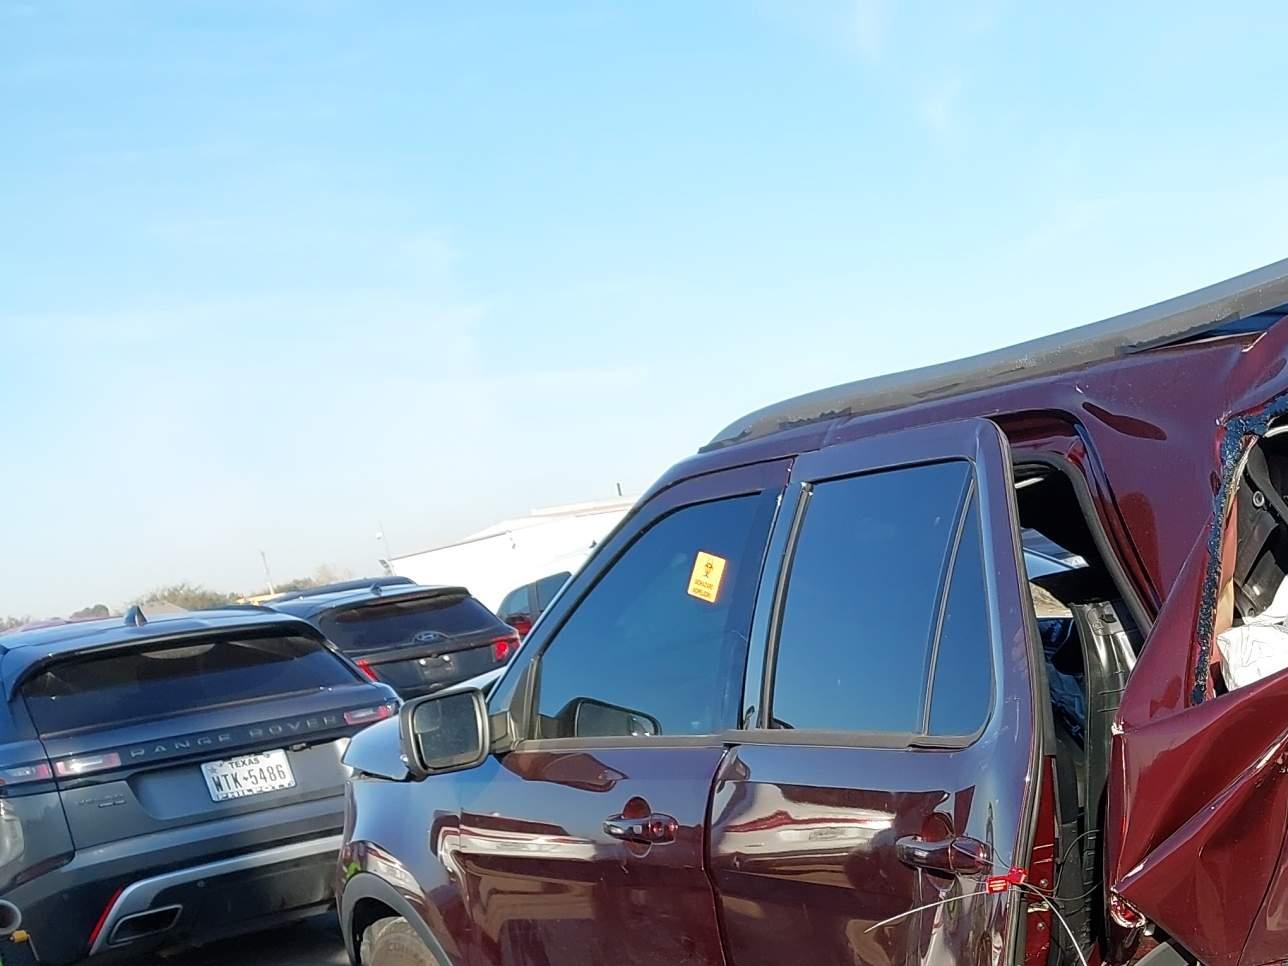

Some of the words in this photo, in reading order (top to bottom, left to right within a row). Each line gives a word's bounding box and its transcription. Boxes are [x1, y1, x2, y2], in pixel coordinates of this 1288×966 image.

[130, 733, 231, 758] RANGE
[249, 715, 336, 738] ROVER
[228, 757, 260, 769] TEXAS
